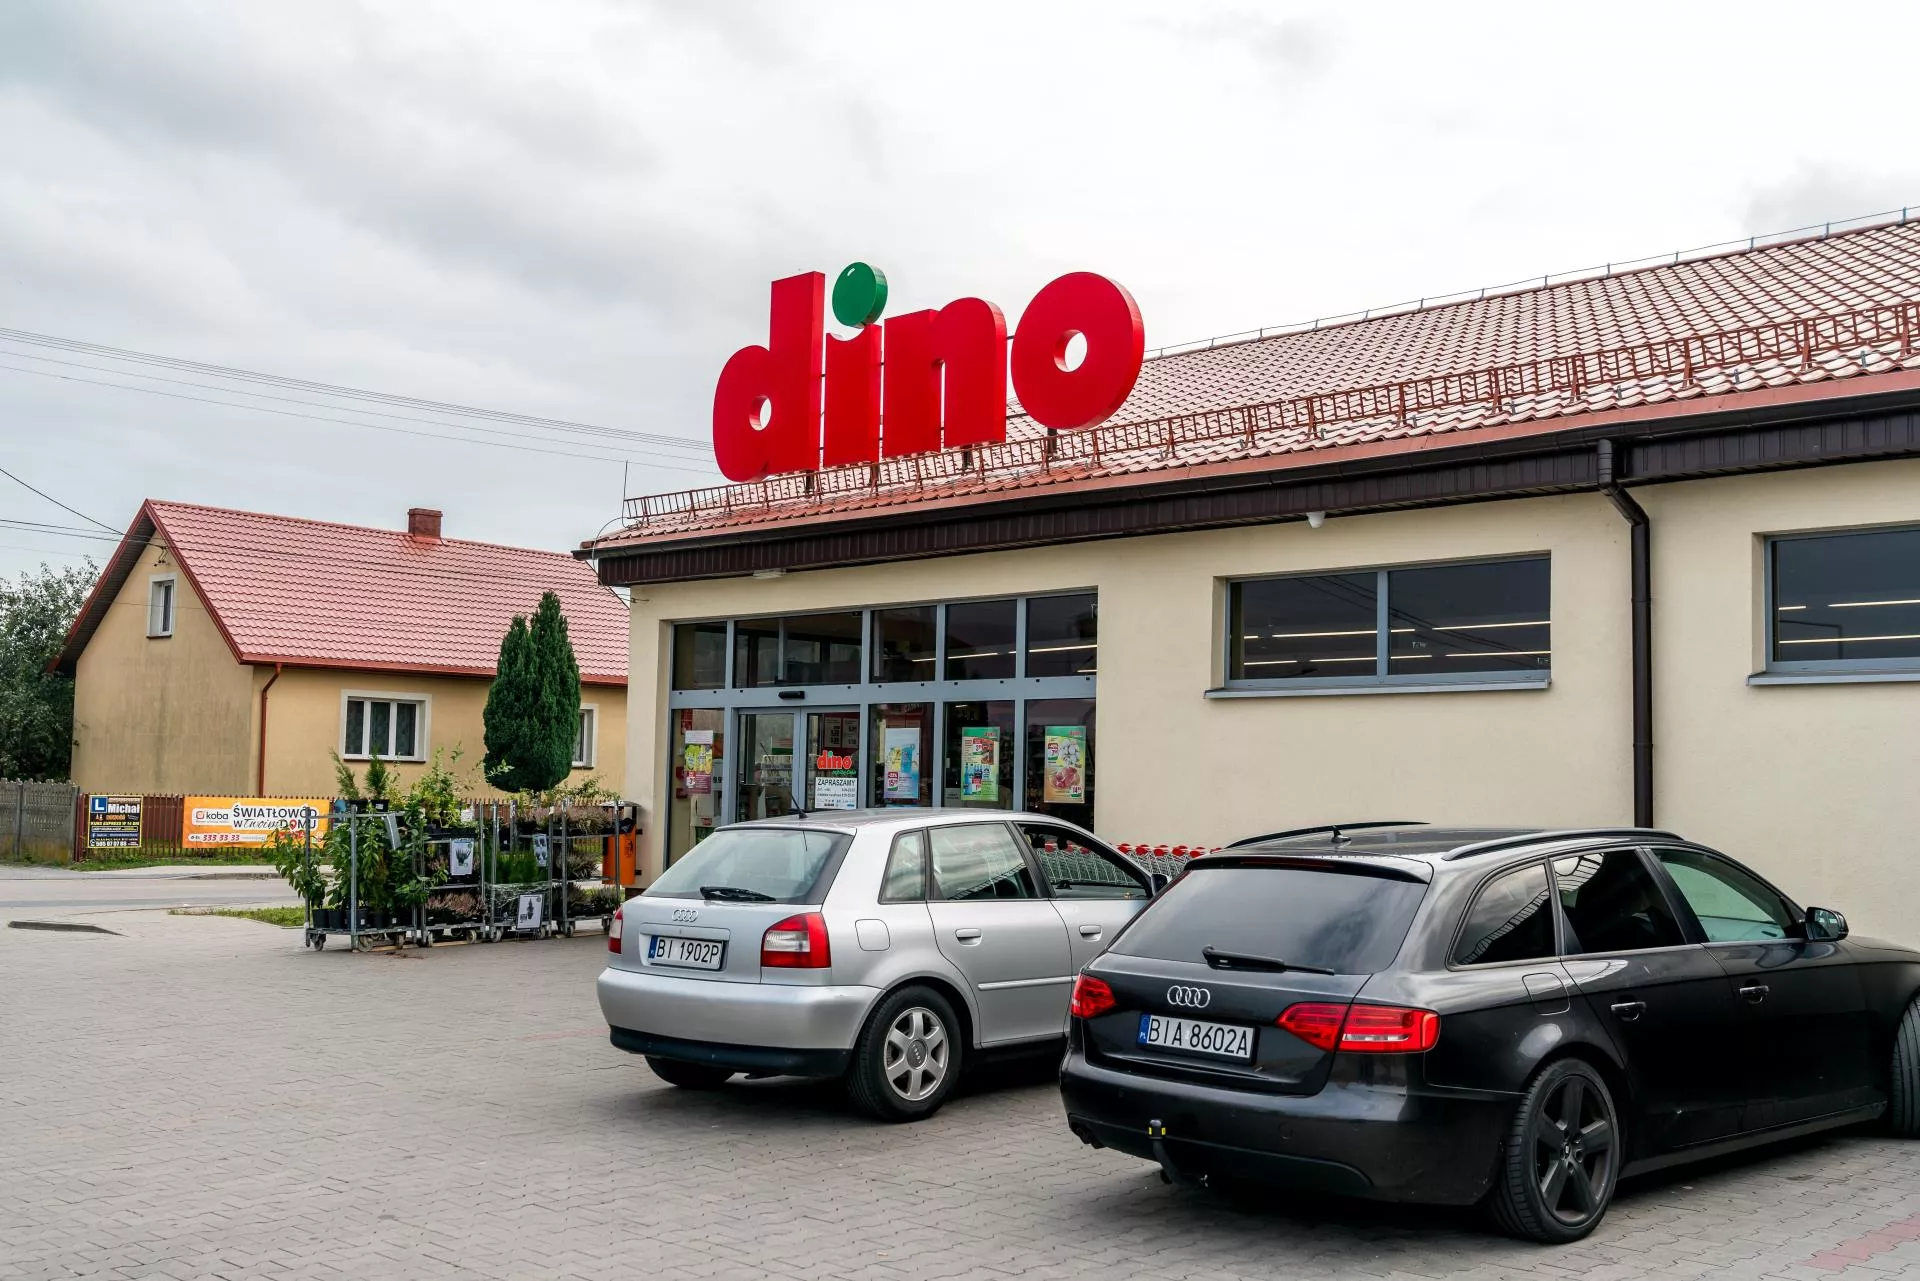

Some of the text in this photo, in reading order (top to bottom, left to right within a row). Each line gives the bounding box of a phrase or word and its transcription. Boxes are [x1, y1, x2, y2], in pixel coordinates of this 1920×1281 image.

[713, 262, 1145, 483] dino
[817, 751, 852, 769] dino
[95, 799, 105, 810] L
[206, 811, 228, 820] koba
[656, 939, 719, 963] BI 1902P
[1148, 1018, 1182, 1046] BIA
[1189, 1024, 1248, 1055] 8602A
